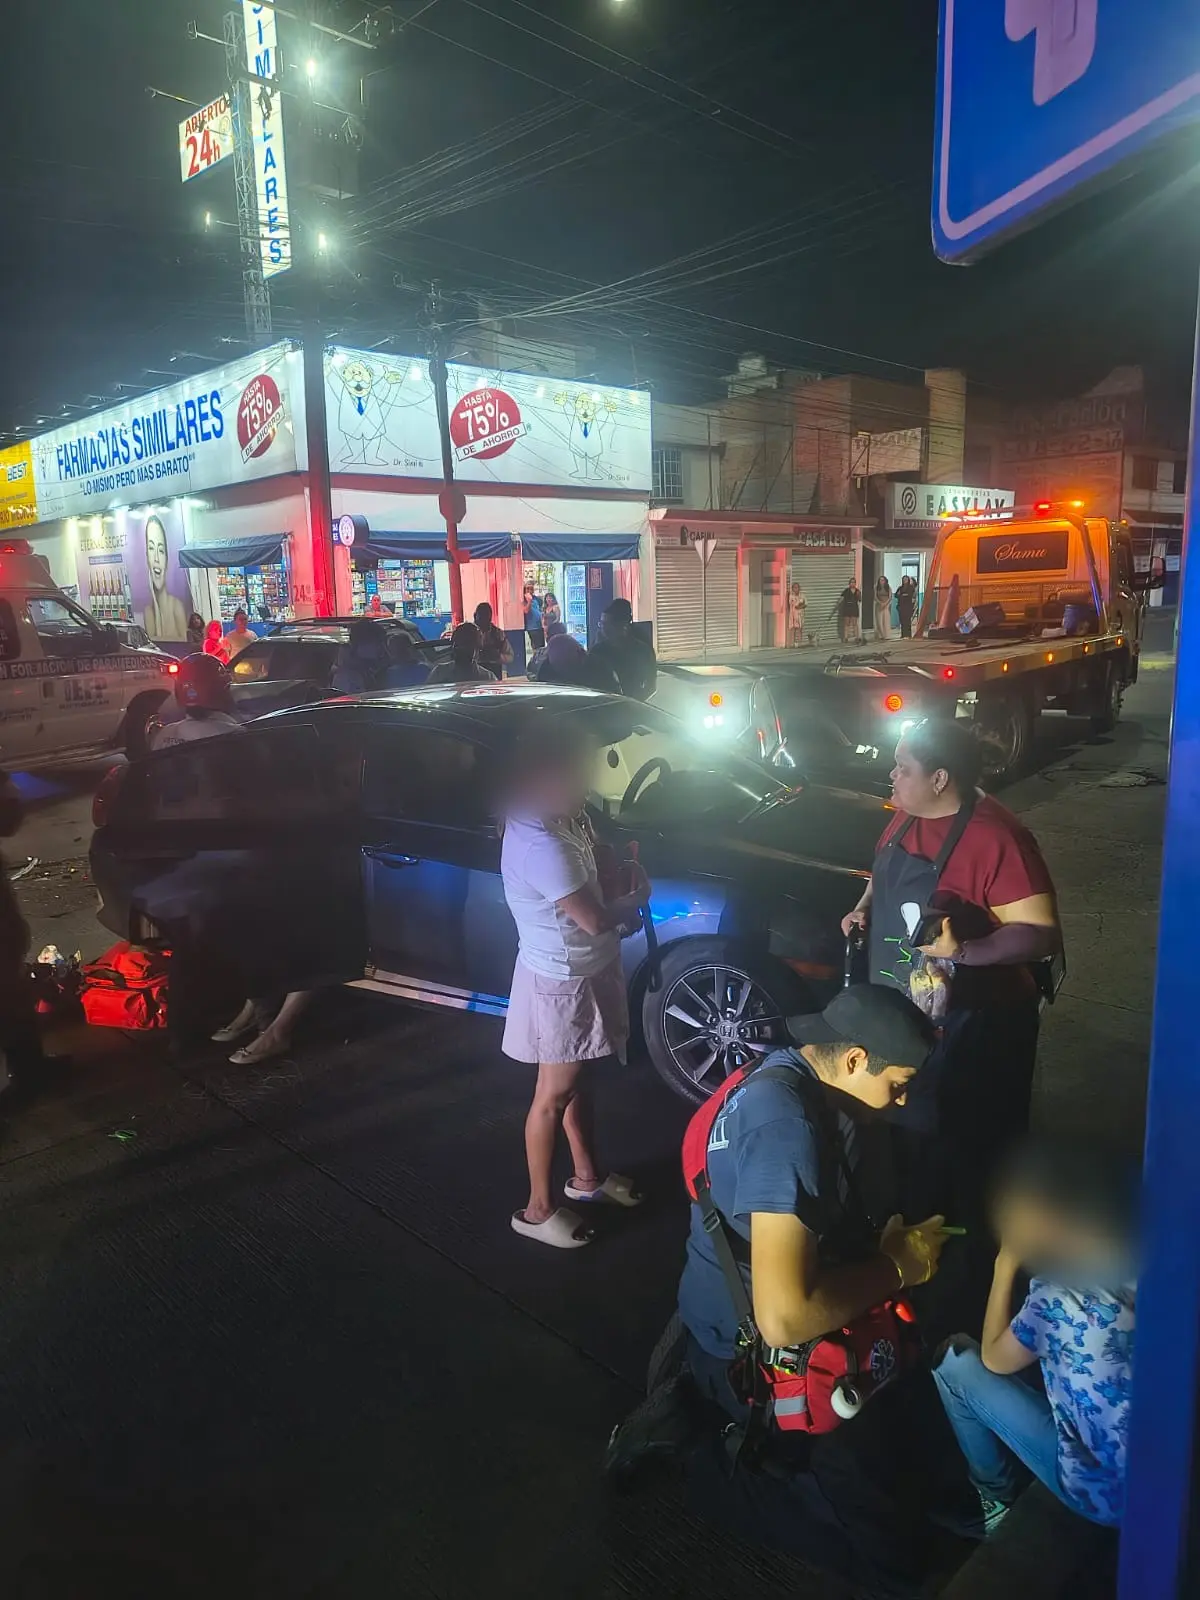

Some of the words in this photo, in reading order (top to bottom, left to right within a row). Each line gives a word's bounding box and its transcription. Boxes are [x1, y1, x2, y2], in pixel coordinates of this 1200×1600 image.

[185, 97, 227, 137] ABIERTO
[186, 128, 220, 177] 24h
[243, 380, 261, 405] HASTA
[463, 391, 492, 407] HASTA
[241, 385, 273, 439] 75%
[459, 399, 510, 440] 75%
[56, 424, 131, 481] FARMACIAS
[132, 390, 224, 460] SIMILARES
[462, 445, 476, 456] DE
[482, 427, 520, 448] AHORRO
[245, 444, 254, 457] DE
[93, 474, 115, 494] MISMO
[116, 469, 136, 489] PERO
[137, 464, 154, 482] MAS
[926, 494, 1005, 518] EASYLAV
[830, 531, 847, 547] LED
[994, 541, 1047, 566] Samu
[78, 658, 91, 671] DE
